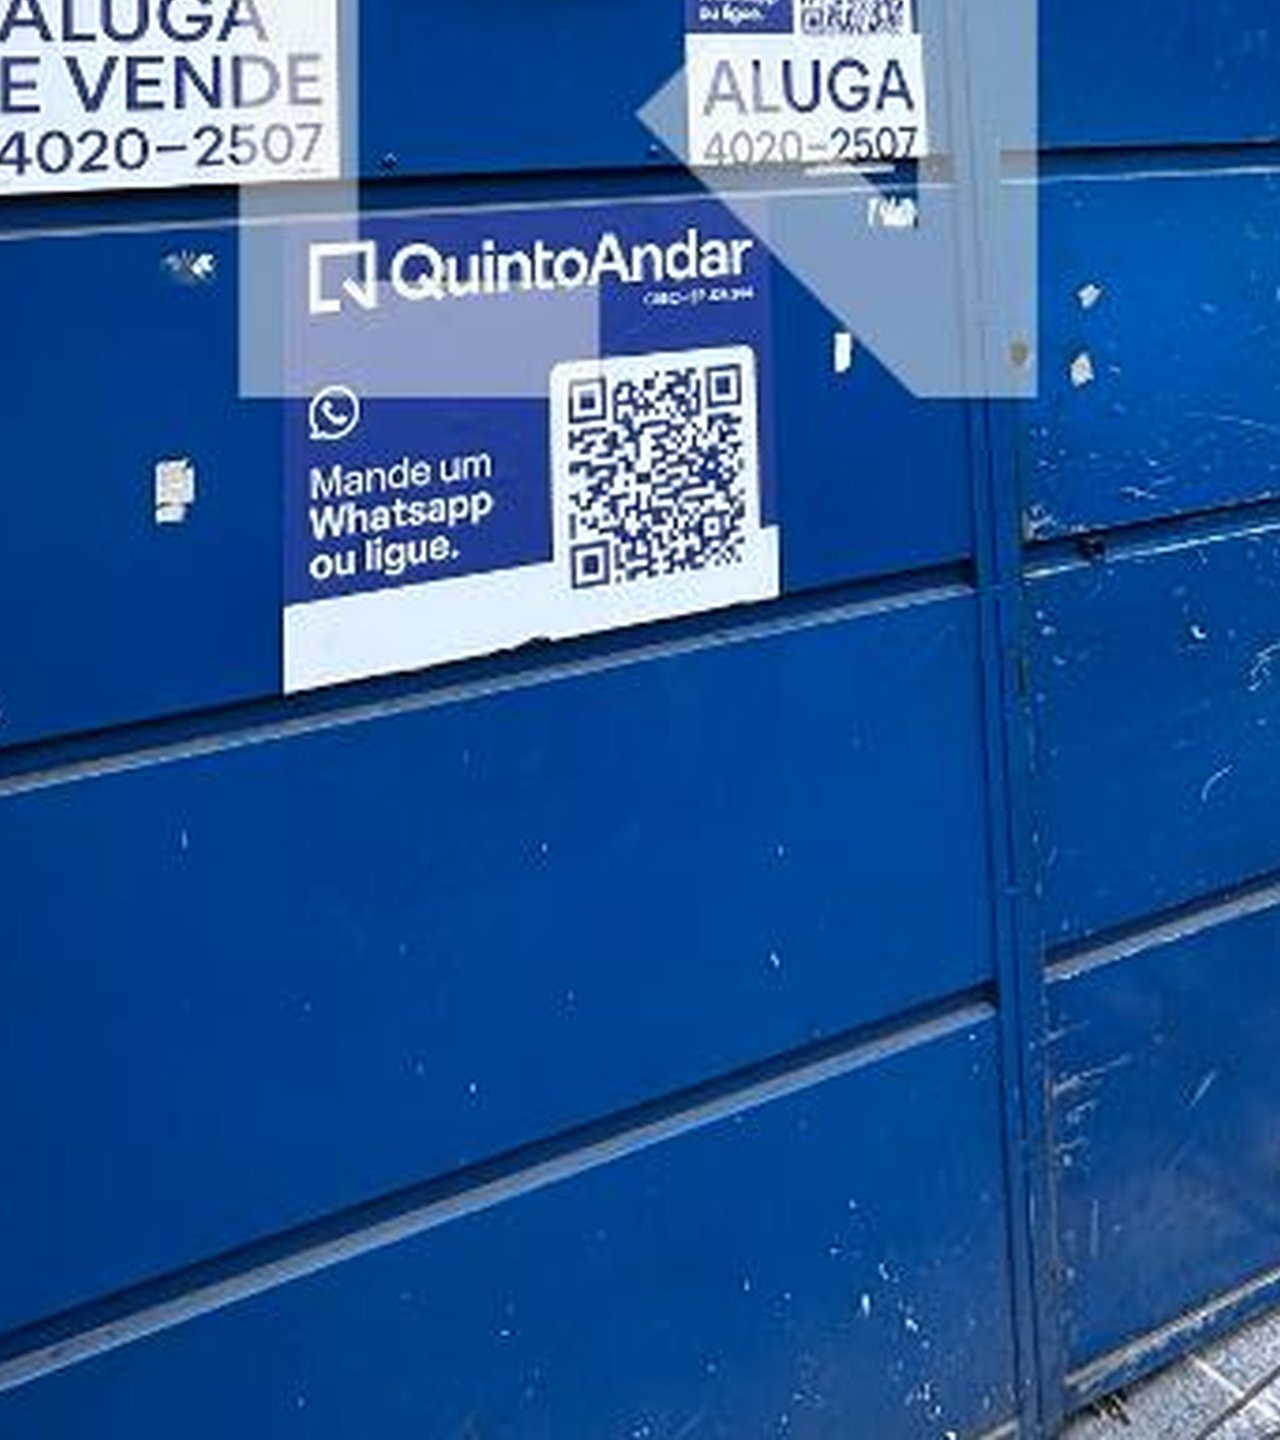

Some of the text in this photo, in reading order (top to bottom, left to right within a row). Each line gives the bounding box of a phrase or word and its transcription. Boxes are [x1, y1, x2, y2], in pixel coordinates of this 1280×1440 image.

[0, 53, 324, 114] E VENDE
[703, 58, 915, 115] ALUGA
[703, 126, 918, 163] 4020-2507
[391, 228, 753, 301] QuintoAndar
[310, 452, 492, 500] Mande um
[310, 490, 493, 540] Whatsapp
[309, 535, 460, 579] ou ligue.
